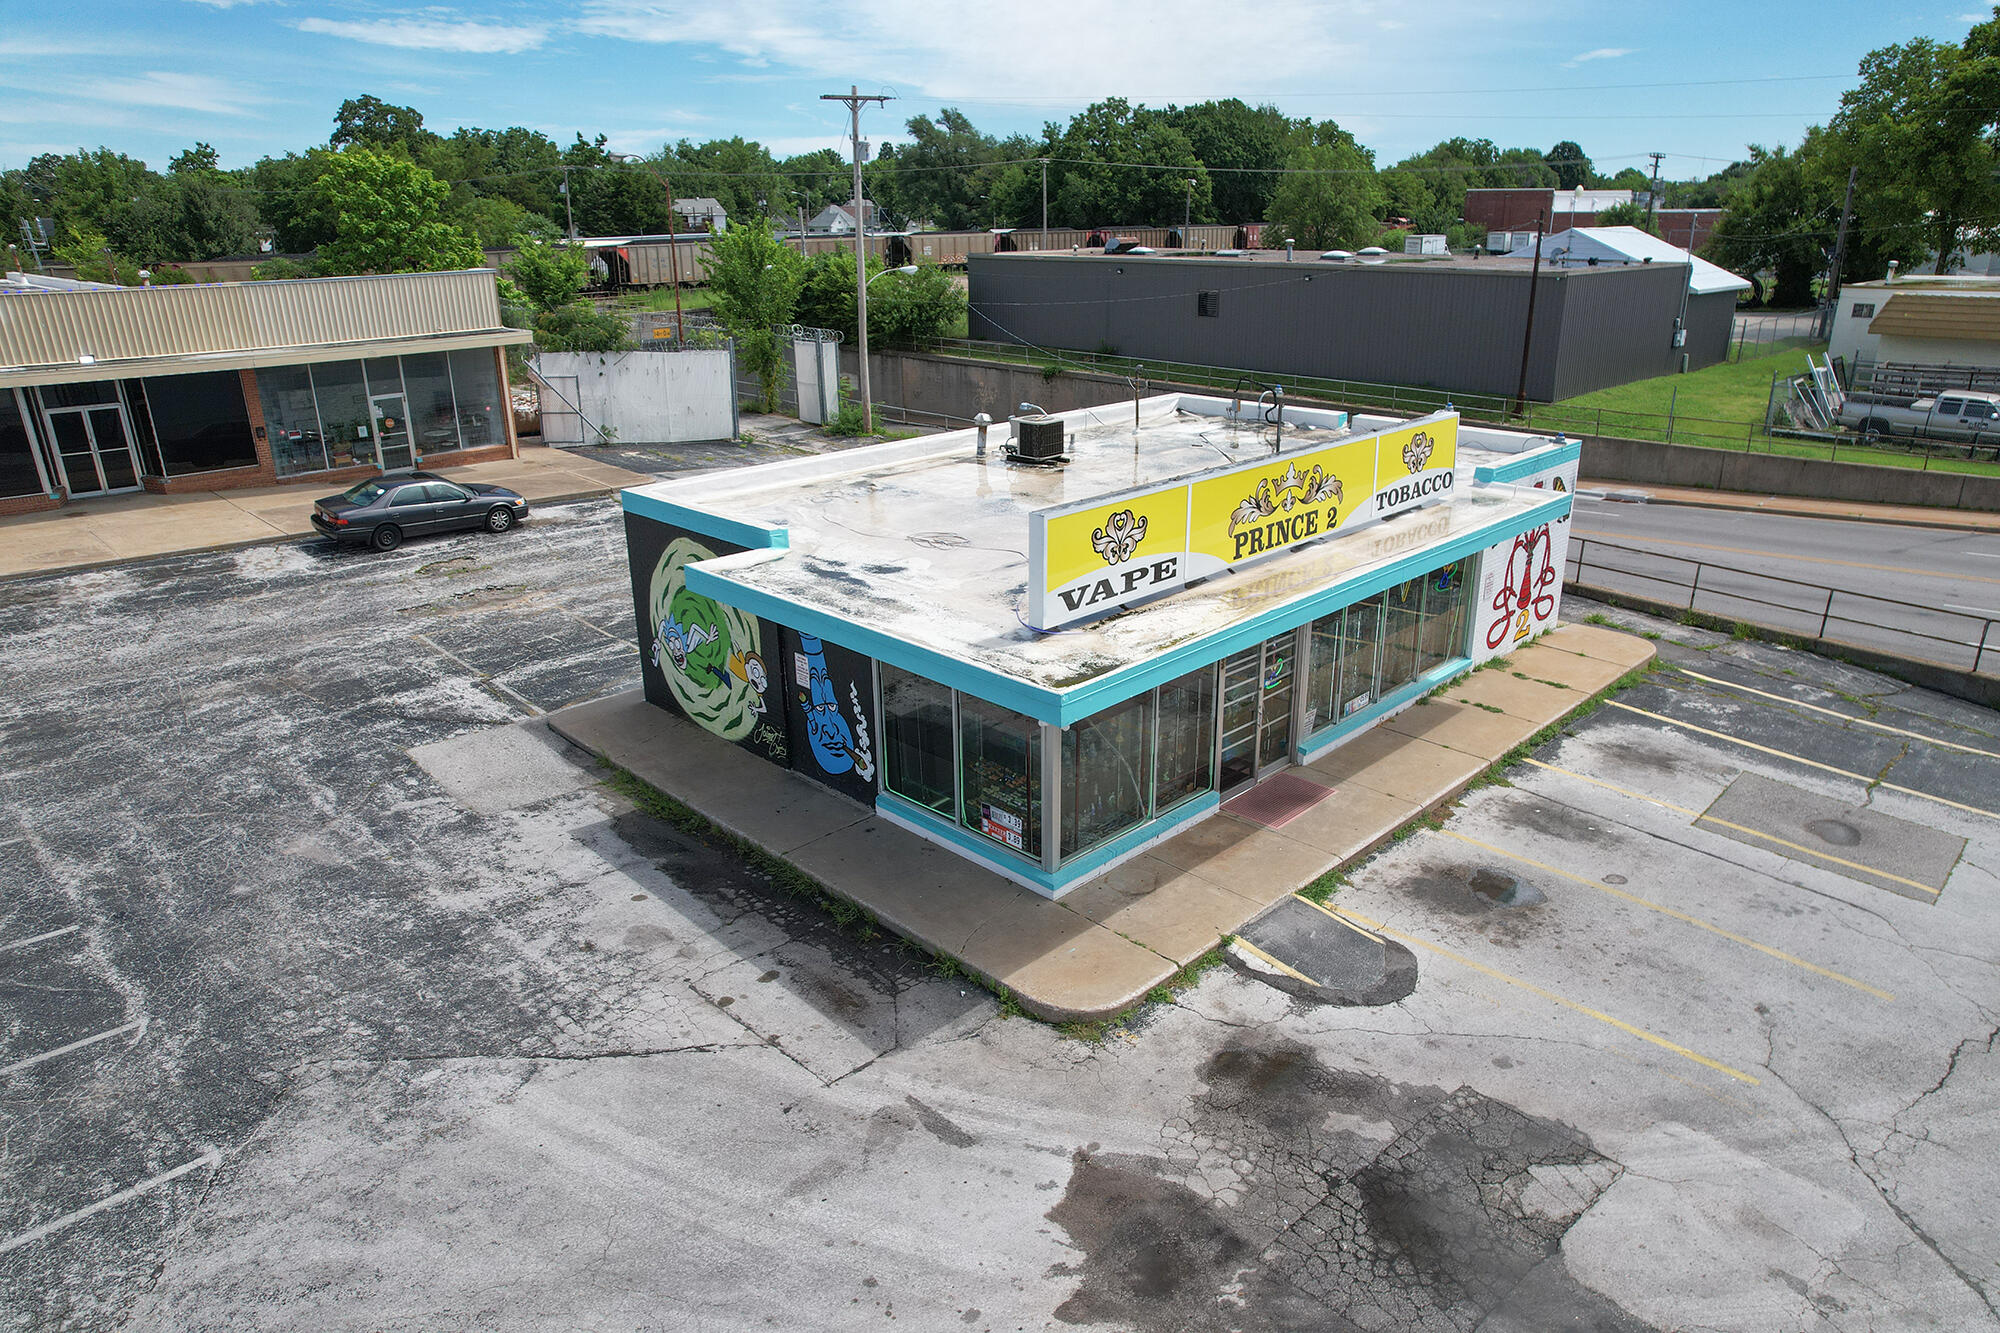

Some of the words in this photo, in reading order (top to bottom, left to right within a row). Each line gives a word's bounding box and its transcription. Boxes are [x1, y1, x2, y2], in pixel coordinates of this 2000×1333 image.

[1376, 472, 1453, 511] TOBACCO
[1233, 509, 1319, 560] PRINCE
[1326, 506, 1338, 530] 2
[1057, 557, 1178, 612] VAPE
[1513, 608, 1531, 643] 2
